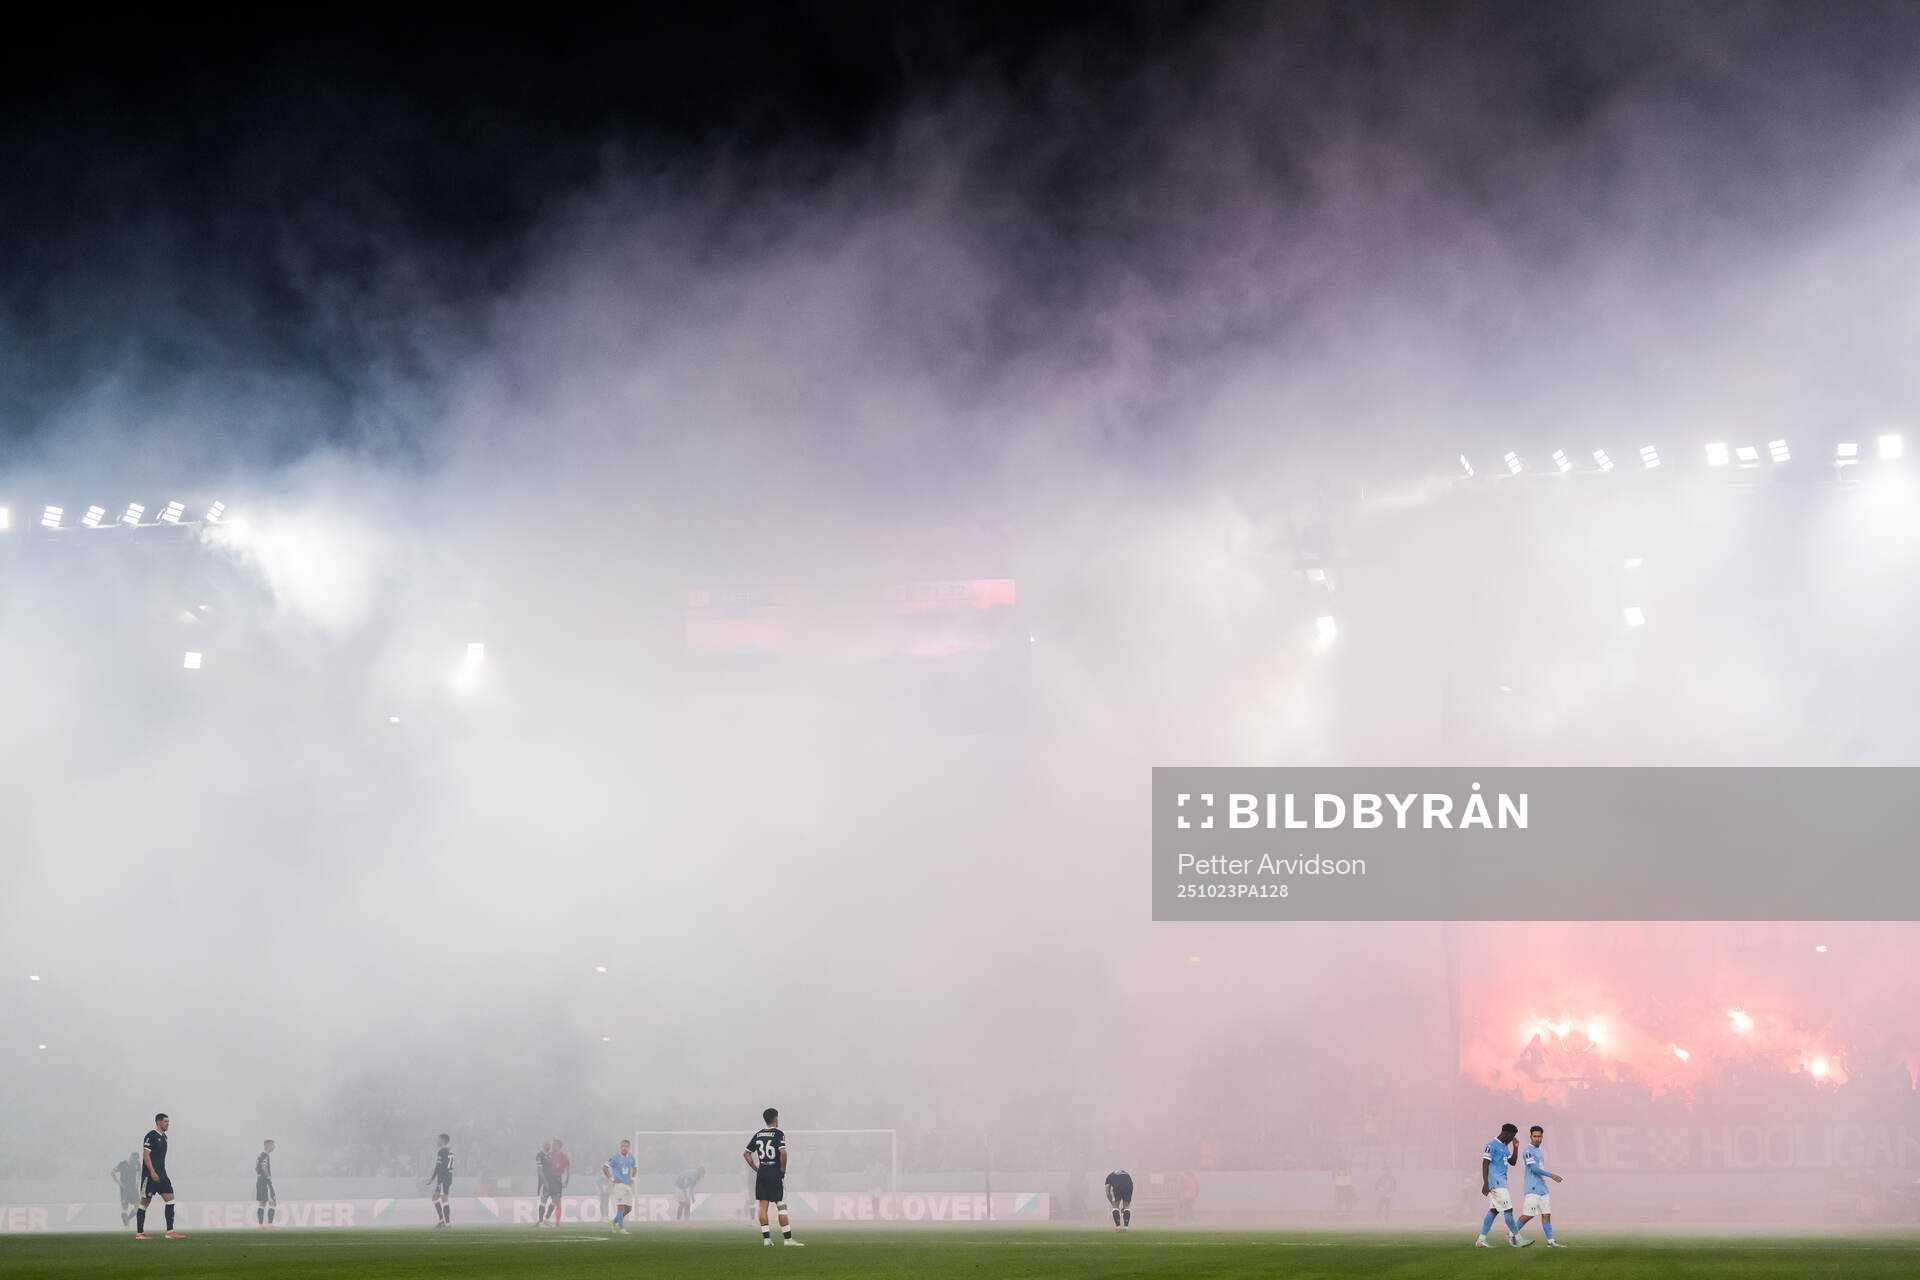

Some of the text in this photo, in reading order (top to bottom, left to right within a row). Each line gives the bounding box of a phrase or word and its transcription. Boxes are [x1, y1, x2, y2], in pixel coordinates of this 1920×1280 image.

[756, 1139, 776, 1160] 36
[1547, 1126, 1638, 1169] LUE
[832, 1194, 998, 1221] RECOVER
